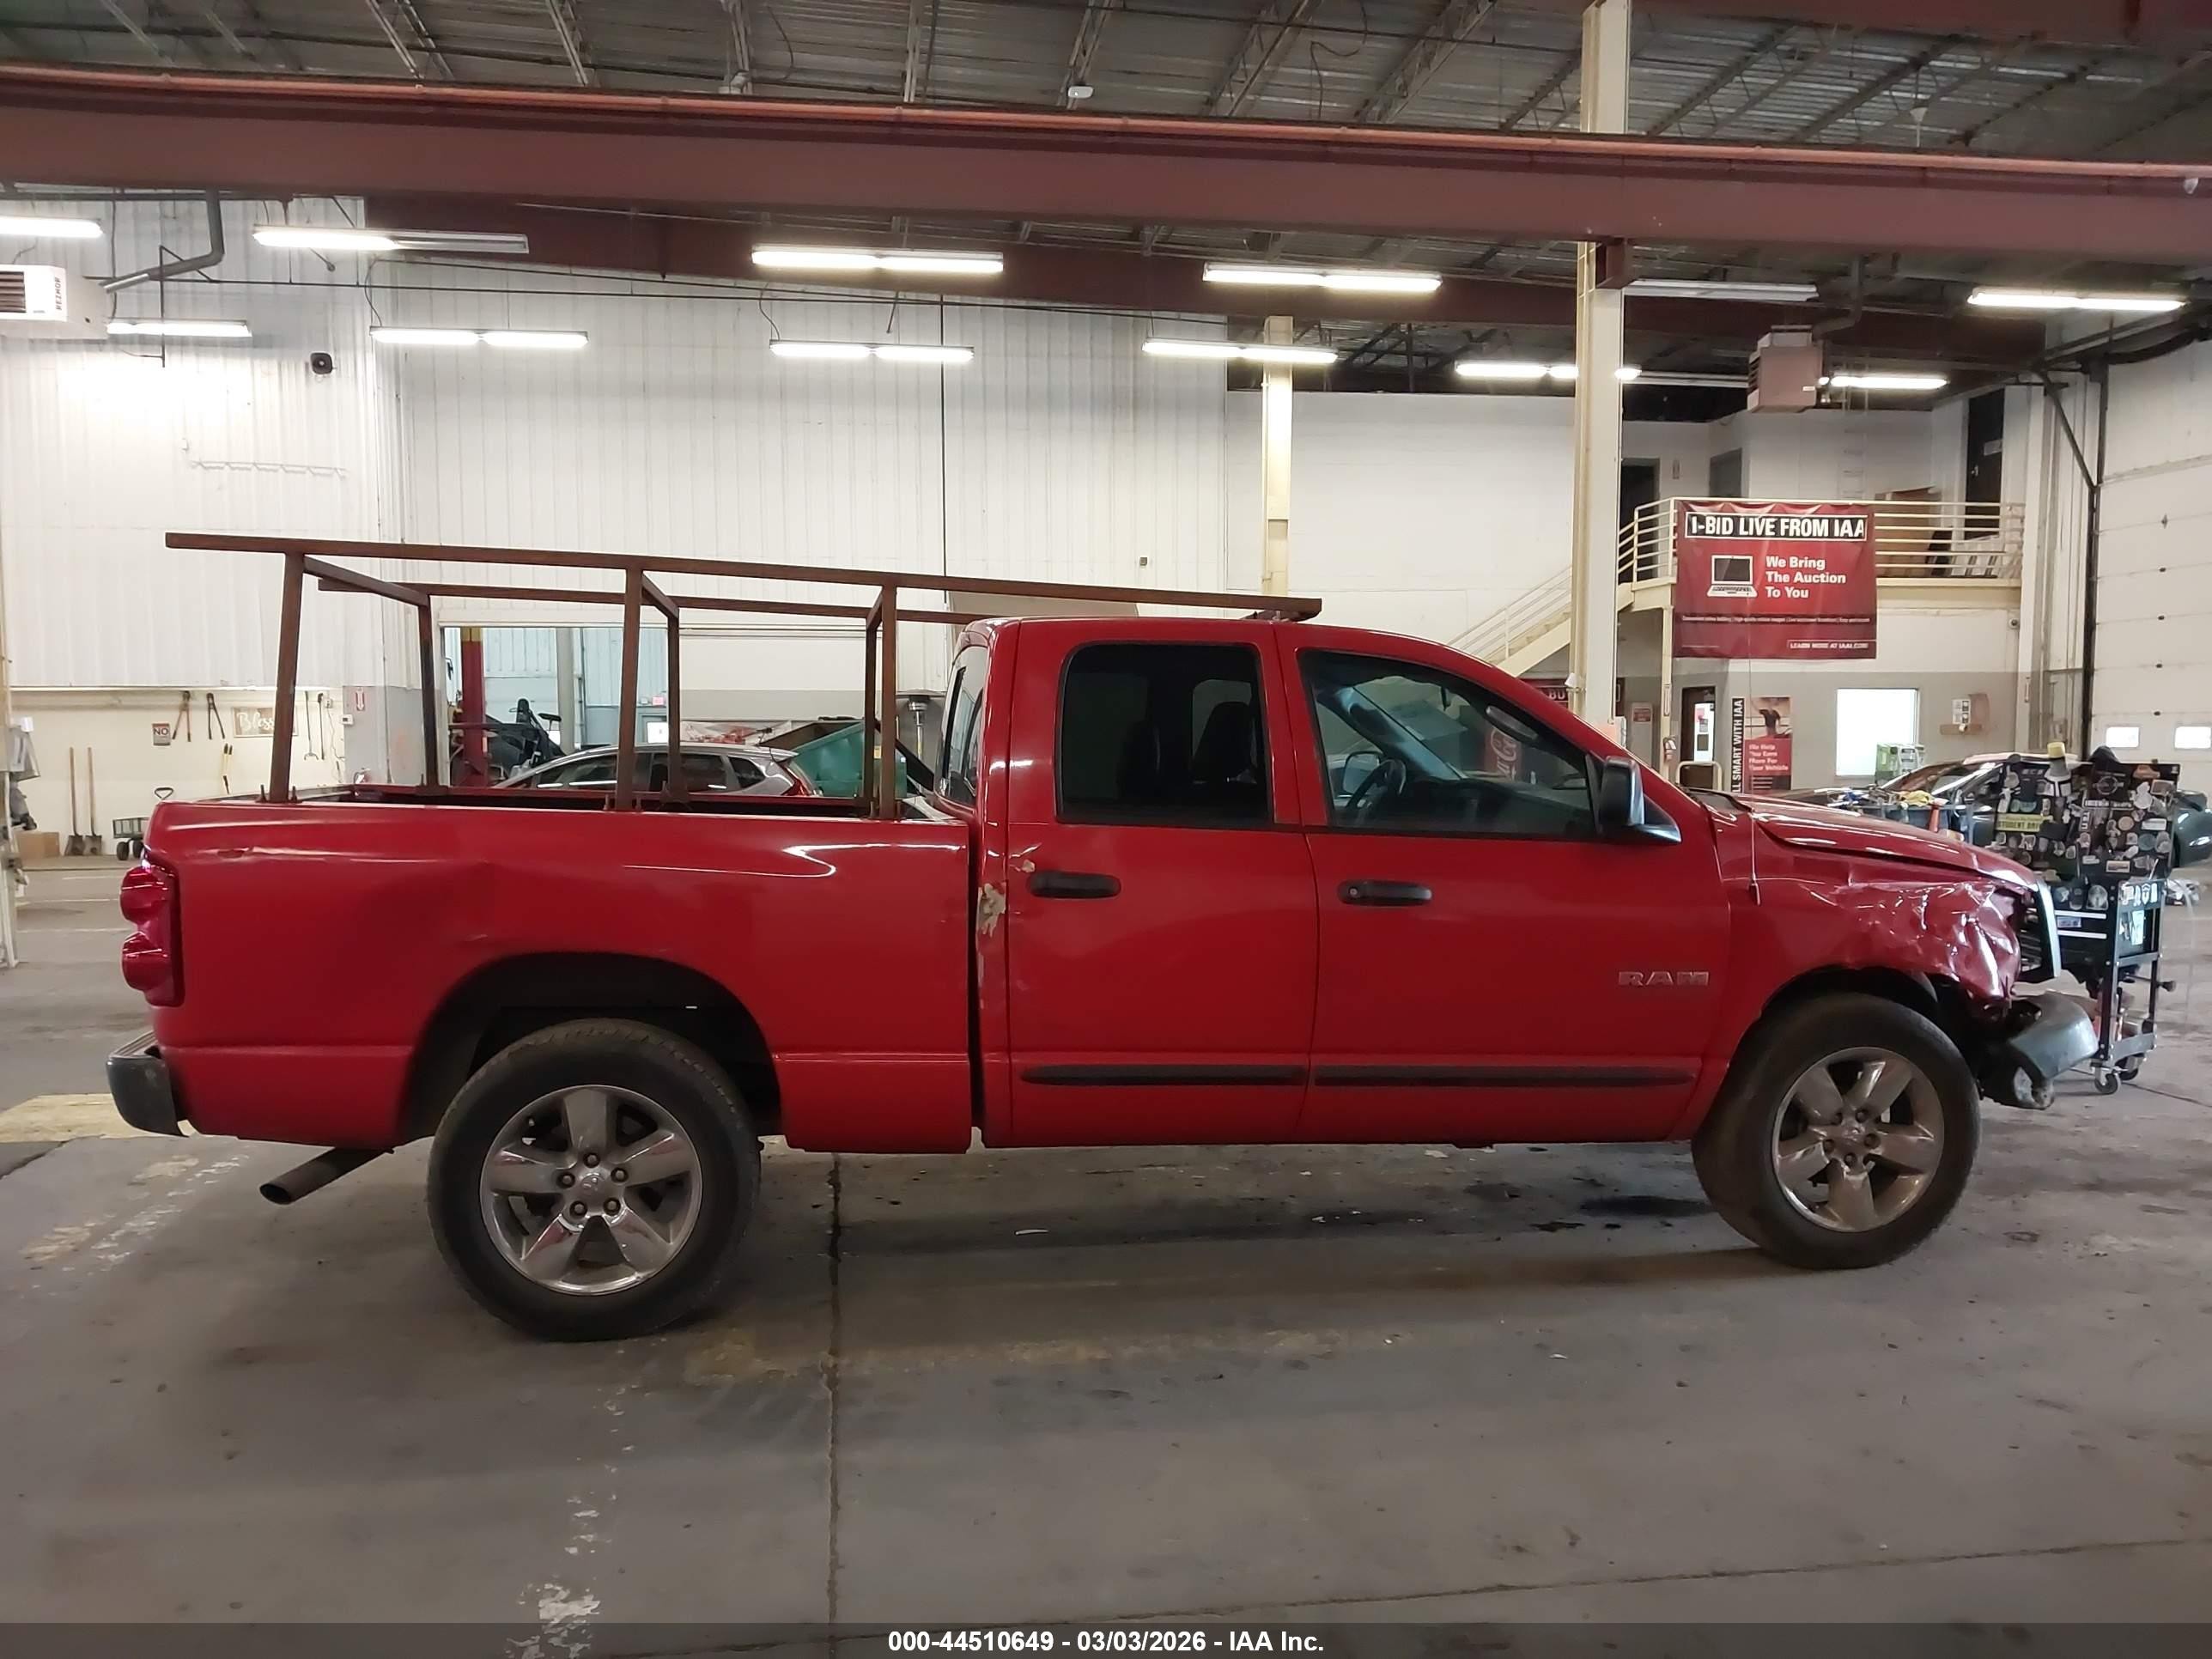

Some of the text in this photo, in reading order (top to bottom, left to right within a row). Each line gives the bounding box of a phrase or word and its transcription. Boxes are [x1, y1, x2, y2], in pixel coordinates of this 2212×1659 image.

[1691, 516, 1864, 538] I-BID LIVE FROM IAA
[1765, 556, 1826, 570] We Bring
[1765, 571, 1846, 584] The Auction
[1765, 586, 1809, 599] To You
[1734, 700, 1743, 717] IAA
[236, 712, 275, 731] Bless
[1733, 719, 1743, 745] WITH
[1733, 747, 1742, 781] SMART
[1618, 970, 1710, 987] RAM
